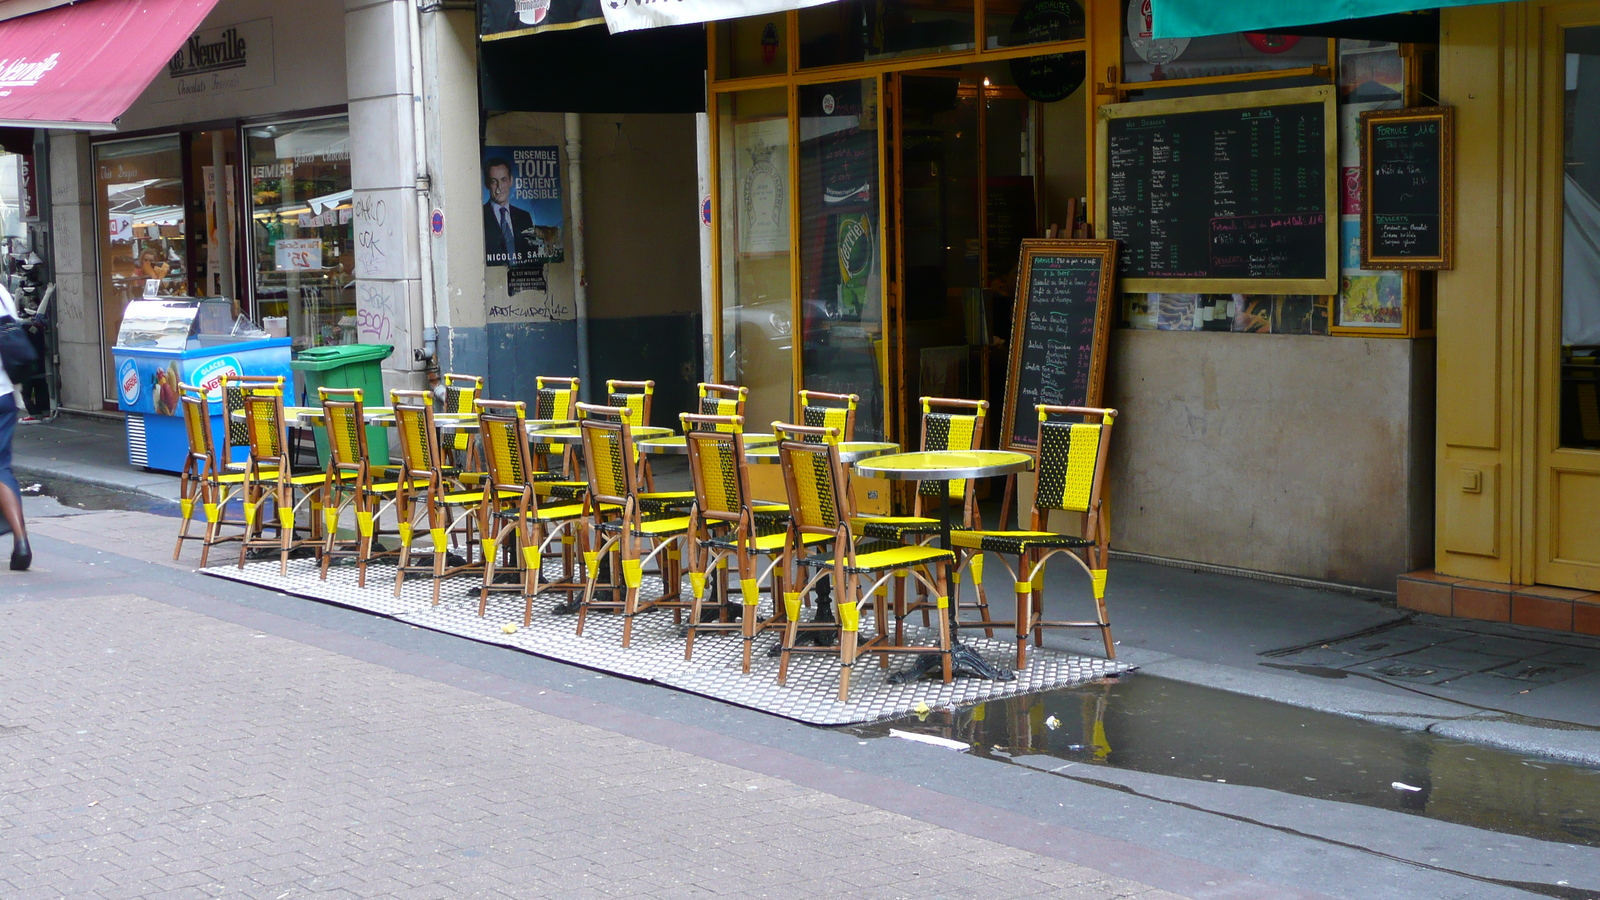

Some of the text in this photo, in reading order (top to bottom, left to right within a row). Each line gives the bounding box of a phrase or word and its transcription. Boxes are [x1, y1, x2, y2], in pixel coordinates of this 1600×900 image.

[187, 28, 246, 68] Neuville
[178, 78, 206, 95] Chocolats
[1377, 125, 1408, 136] FORMULE
[513, 150, 557, 160] ENSEMBLE
[515, 160, 557, 178] TOUT
[516, 178, 557, 189] DEVIENT
[516, 189, 558, 200] POSSIBLE
[486, 252, 523, 262] NICOLAS
[200, 359, 227, 376] GLACES
